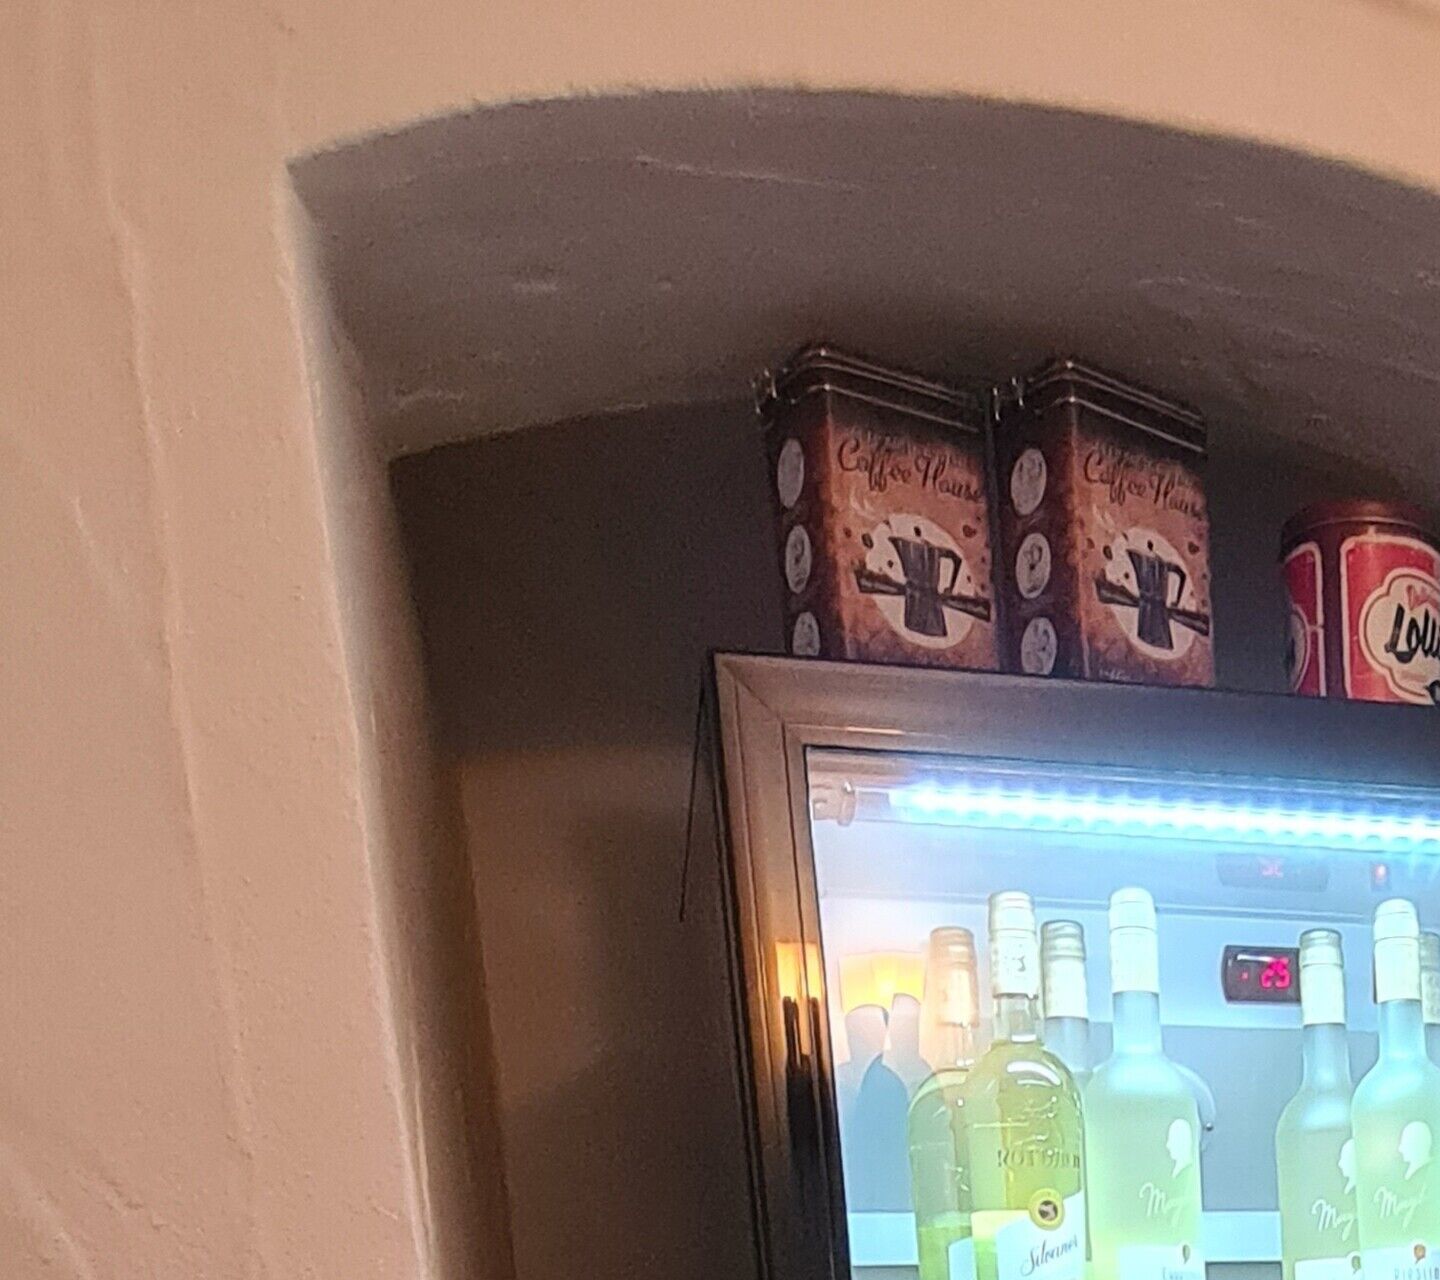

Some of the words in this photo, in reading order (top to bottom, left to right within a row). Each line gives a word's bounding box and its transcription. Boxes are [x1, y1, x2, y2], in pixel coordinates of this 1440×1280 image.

[838, 438, 912, 493] Coffee
[1084, 450, 1147, 506] Coffee
[1020, 1234, 1078, 1277] Silvaner
